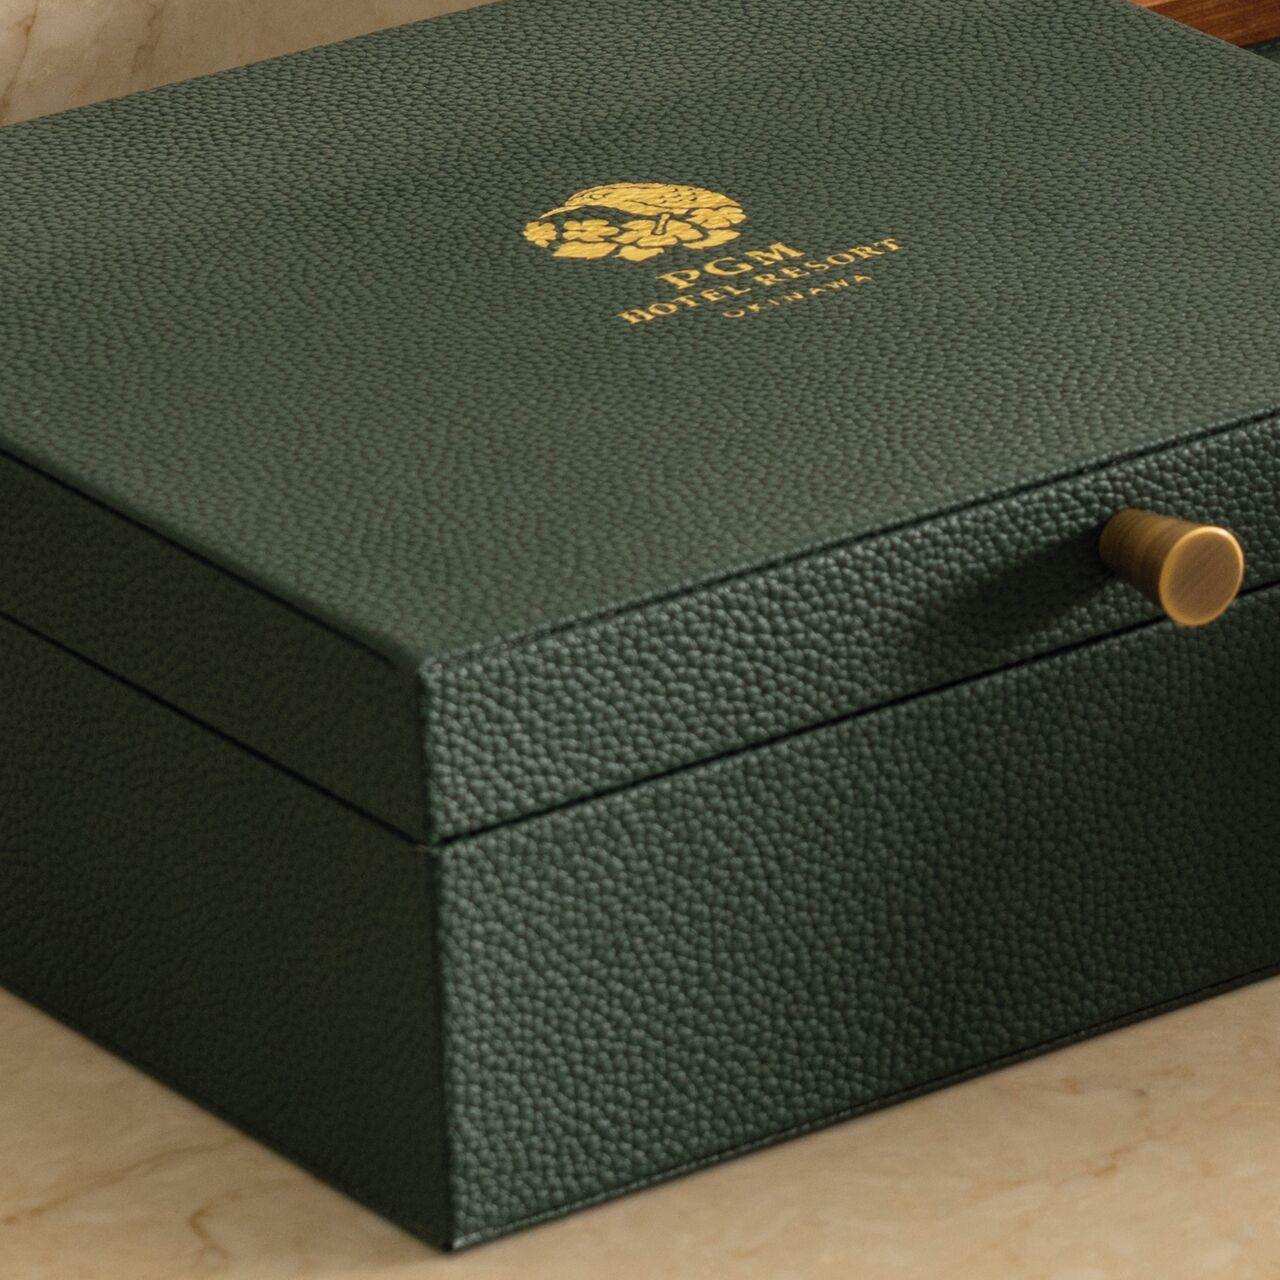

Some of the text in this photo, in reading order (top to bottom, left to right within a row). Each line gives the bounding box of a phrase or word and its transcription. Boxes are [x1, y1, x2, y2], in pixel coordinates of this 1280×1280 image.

[616, 238, 904, 325] HOTEL RESORT
[656, 242, 806, 290] PGM
[722, 274, 874, 319] OKINAWA
